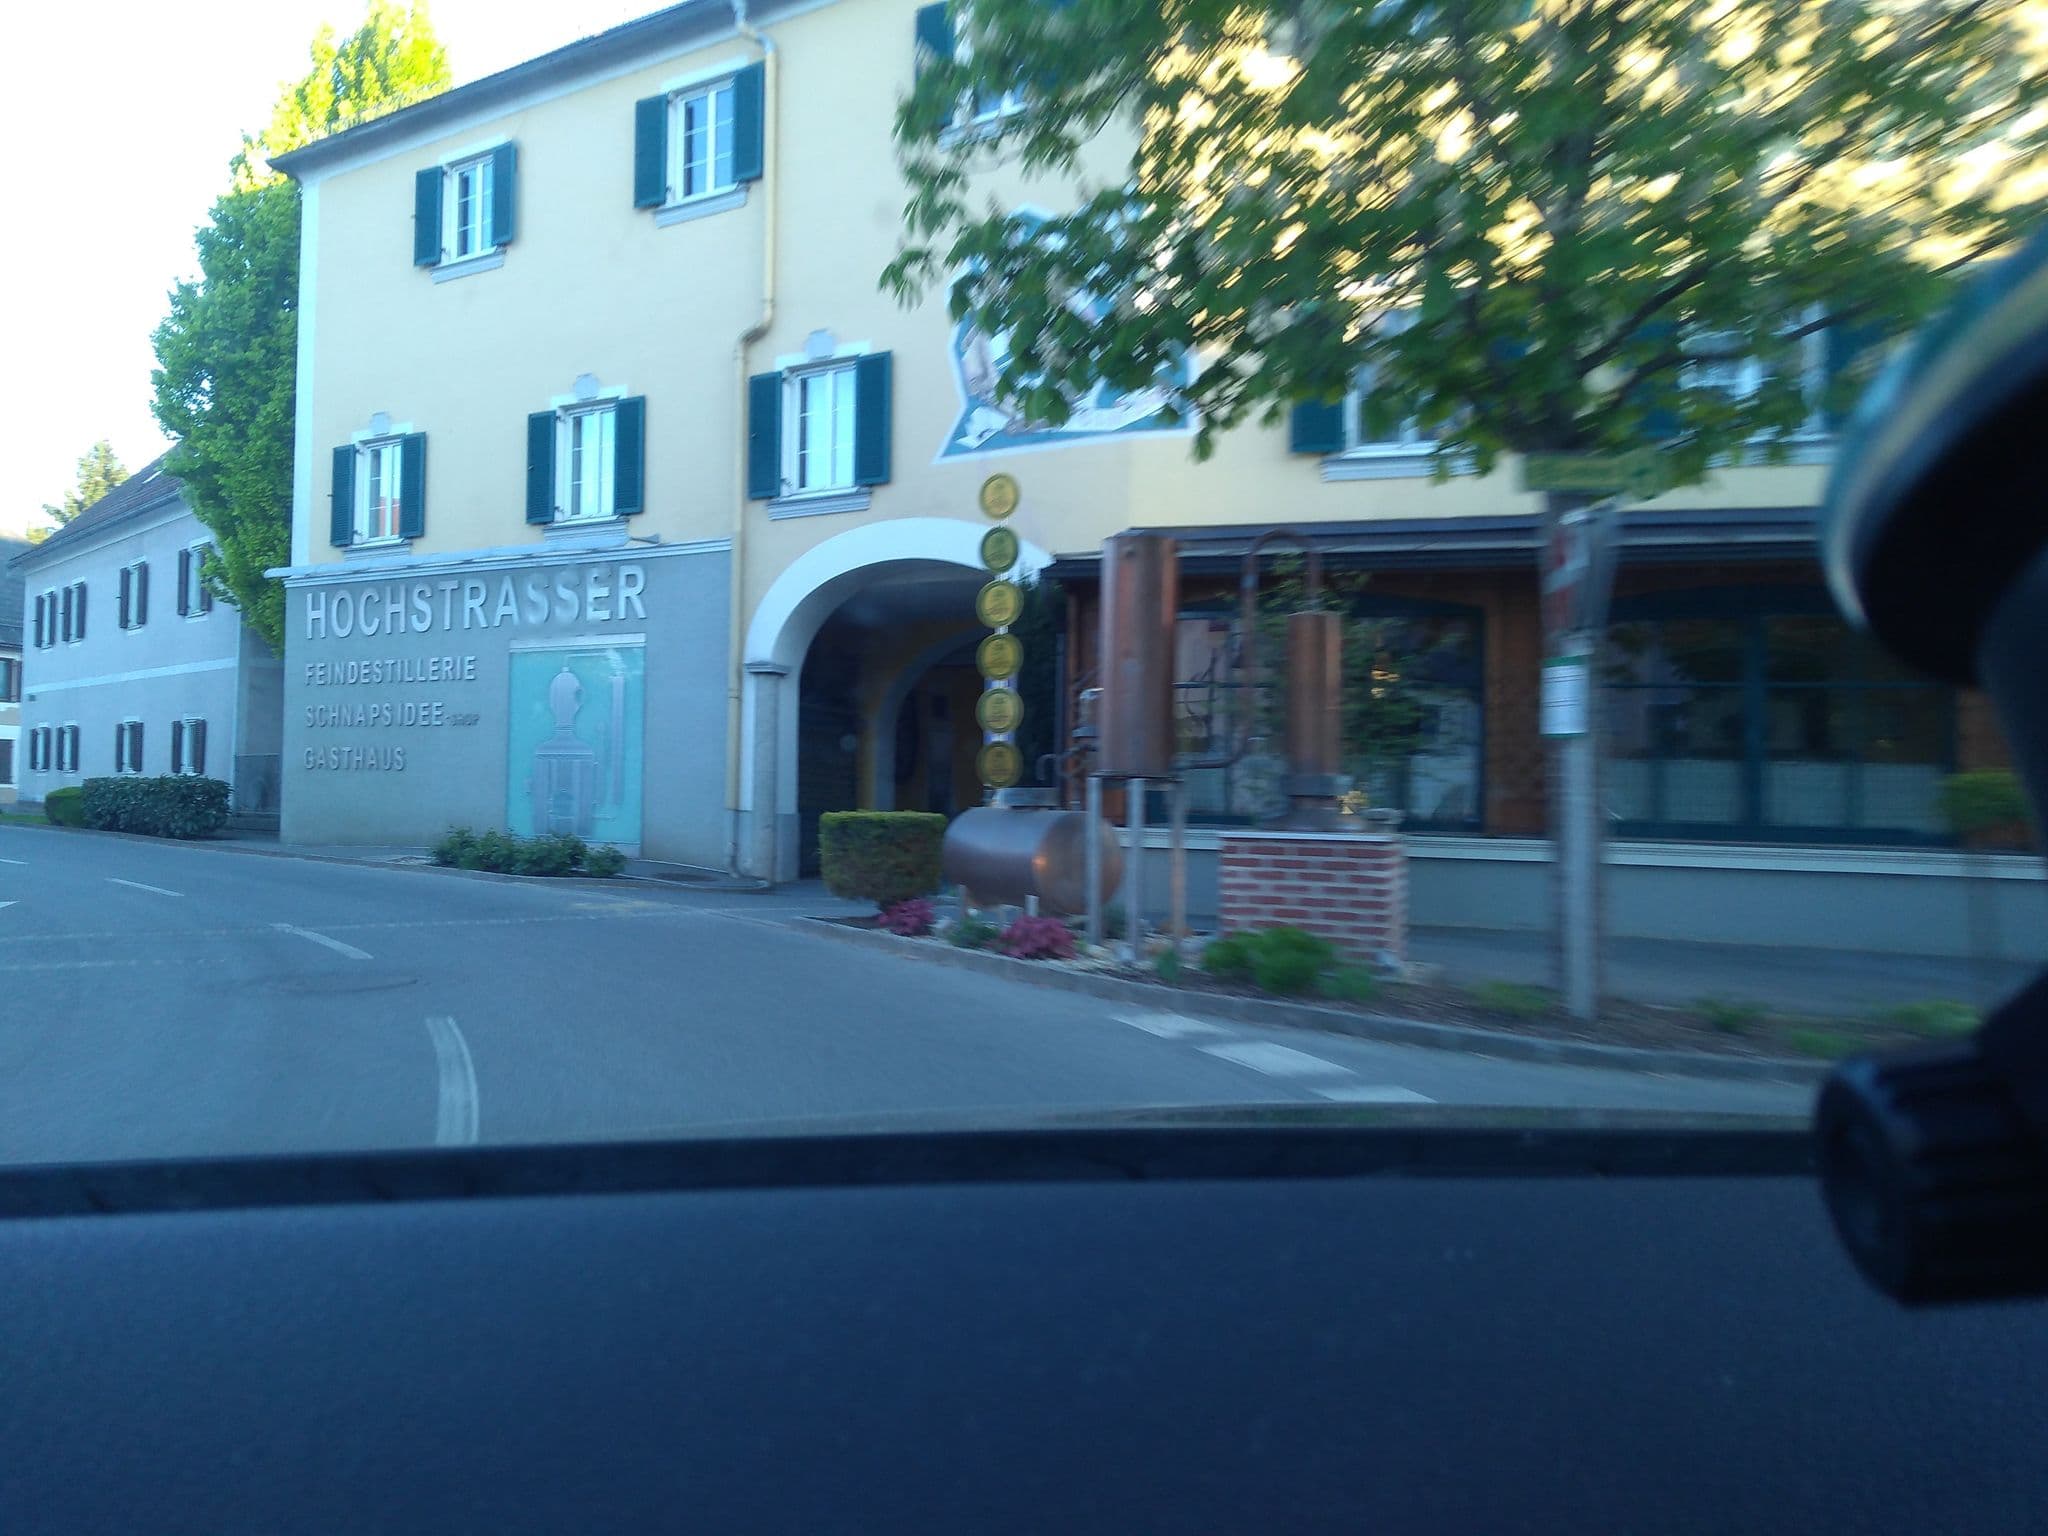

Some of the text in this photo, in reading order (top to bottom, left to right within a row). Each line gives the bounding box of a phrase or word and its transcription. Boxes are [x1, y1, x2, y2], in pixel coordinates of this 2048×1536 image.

[305, 564, 647, 640] HOCHSTRASSER
[304, 655, 477, 686] FEINDESTILLERIE
[303, 746, 406, 771] GASTHAUS
